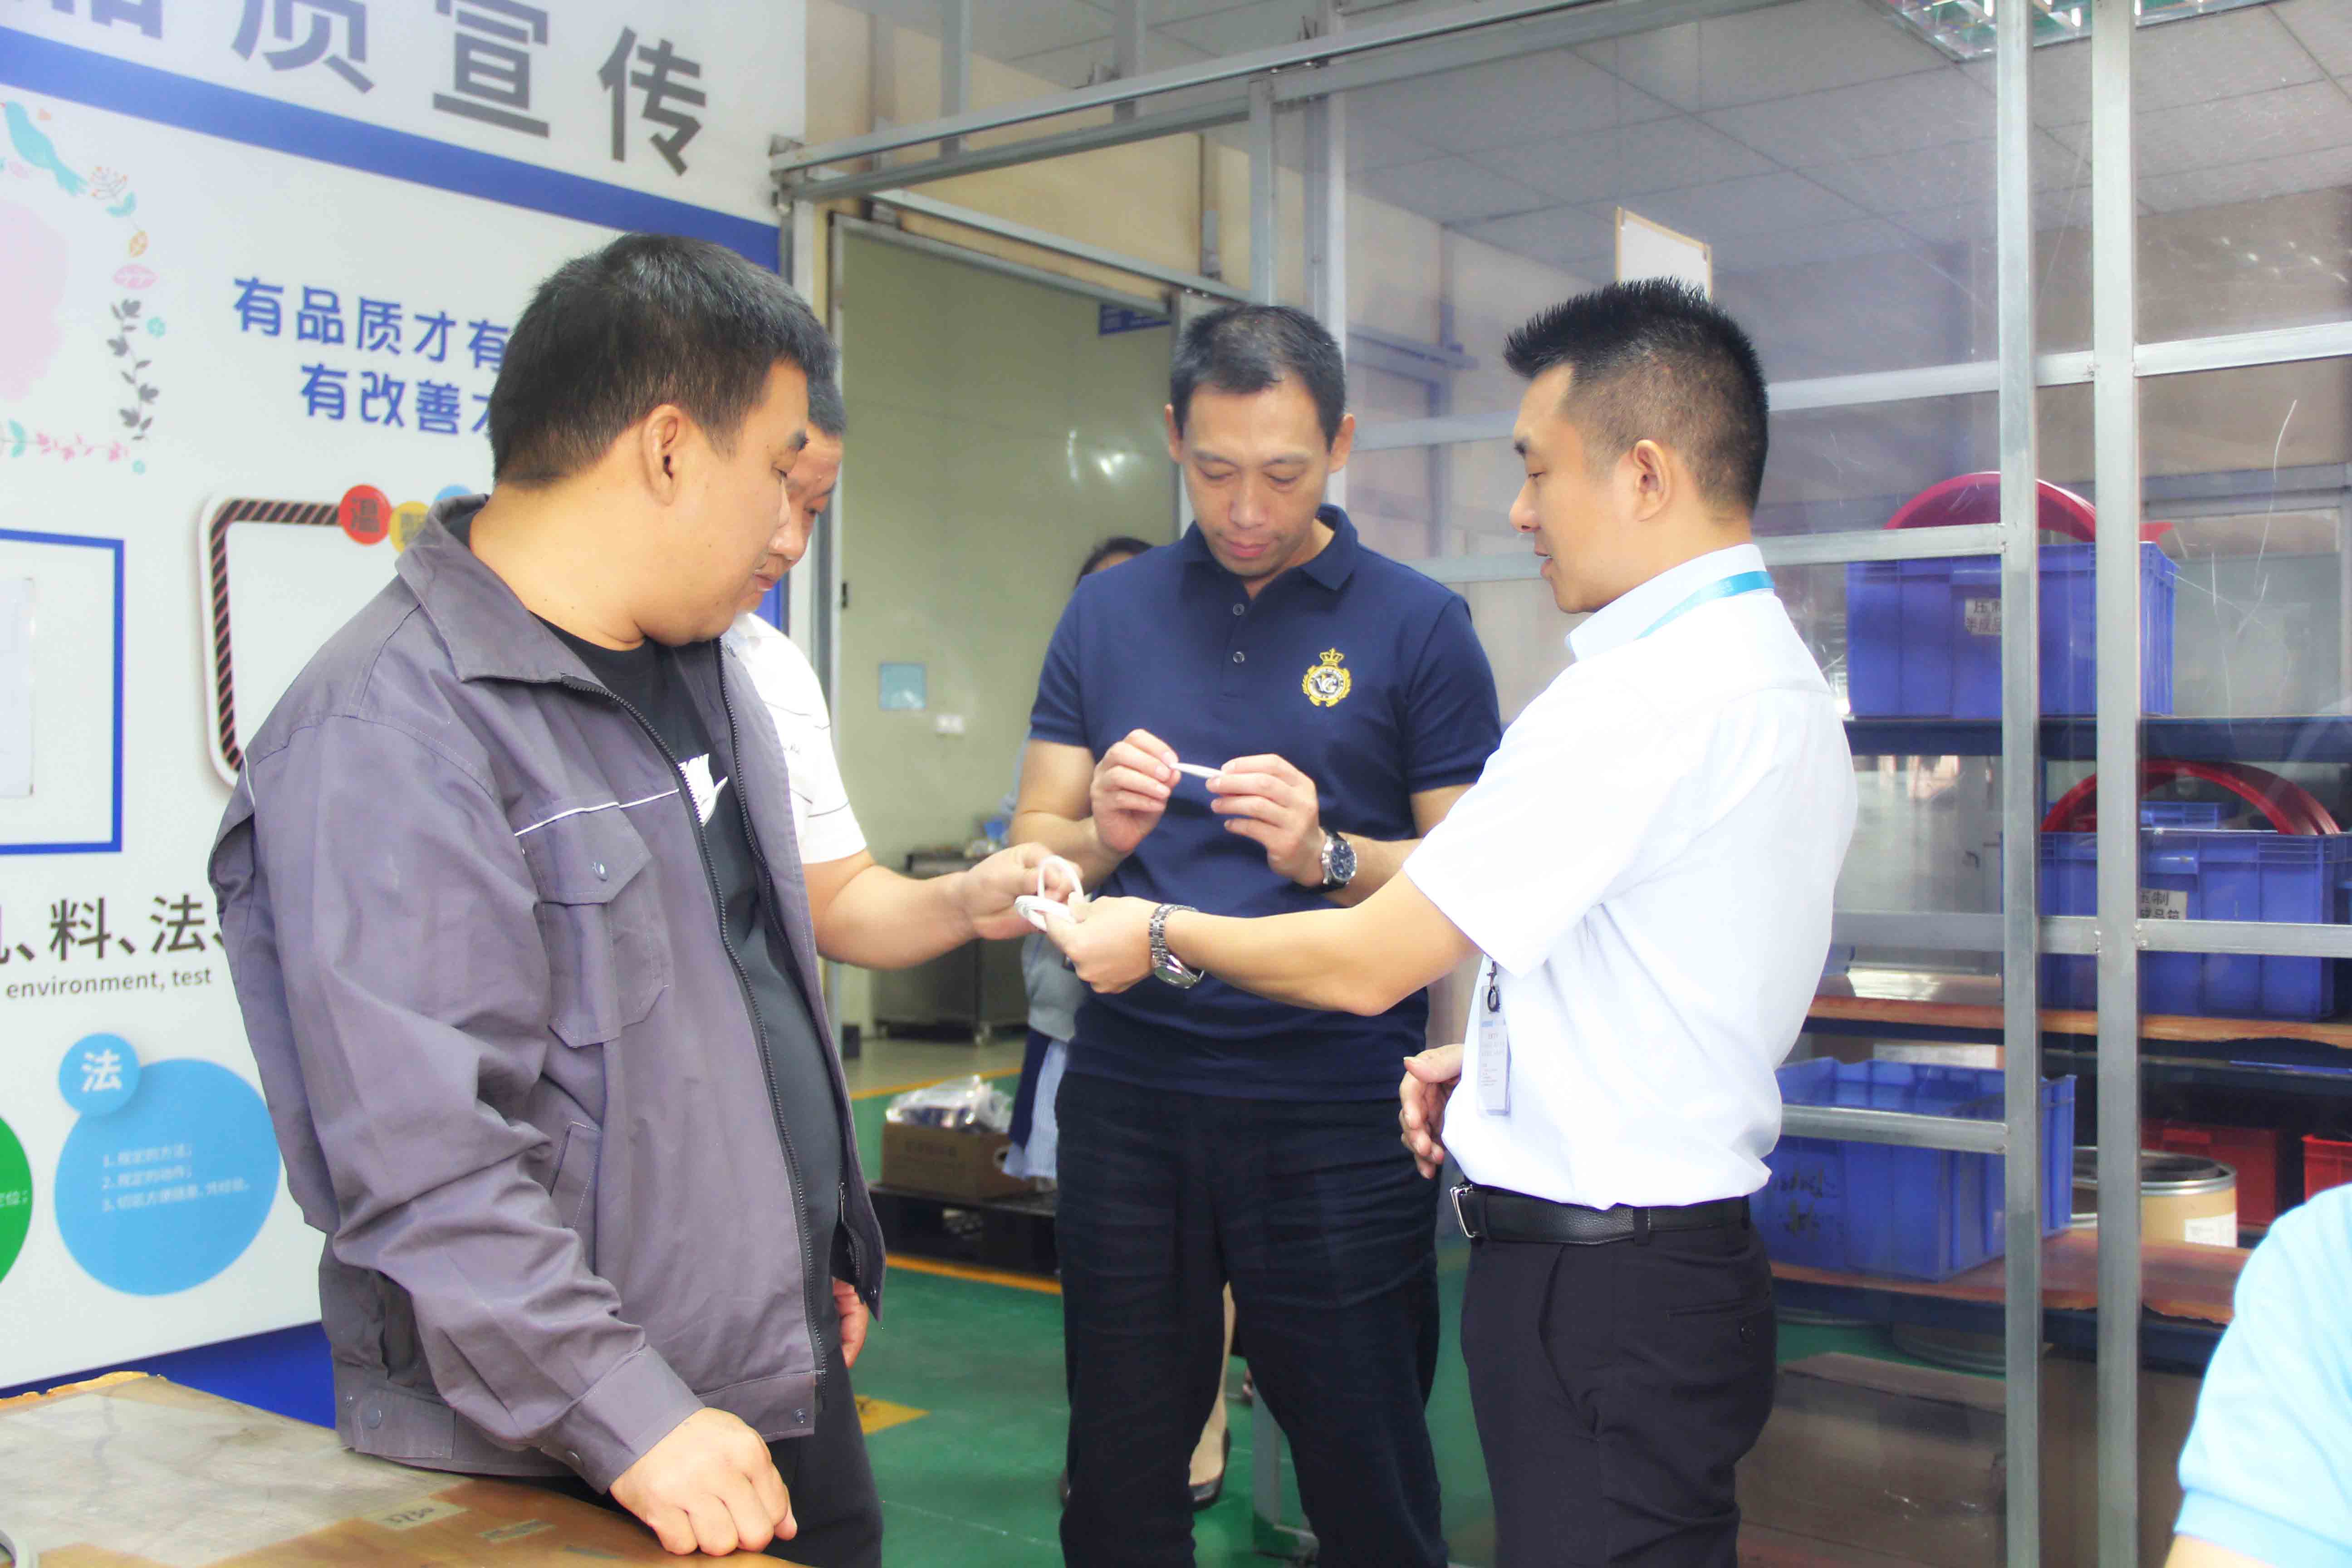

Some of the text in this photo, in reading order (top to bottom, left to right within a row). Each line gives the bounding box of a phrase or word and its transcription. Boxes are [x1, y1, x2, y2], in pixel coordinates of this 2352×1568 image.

[17, 0, 706, 176] 质宣传
[233, 276, 510, 374] 有品质才有
[0, 894, 224, 964] 、料、法、
[6, 967, 211, 999] environment, test
[81, 1049, 122, 1093] 法
